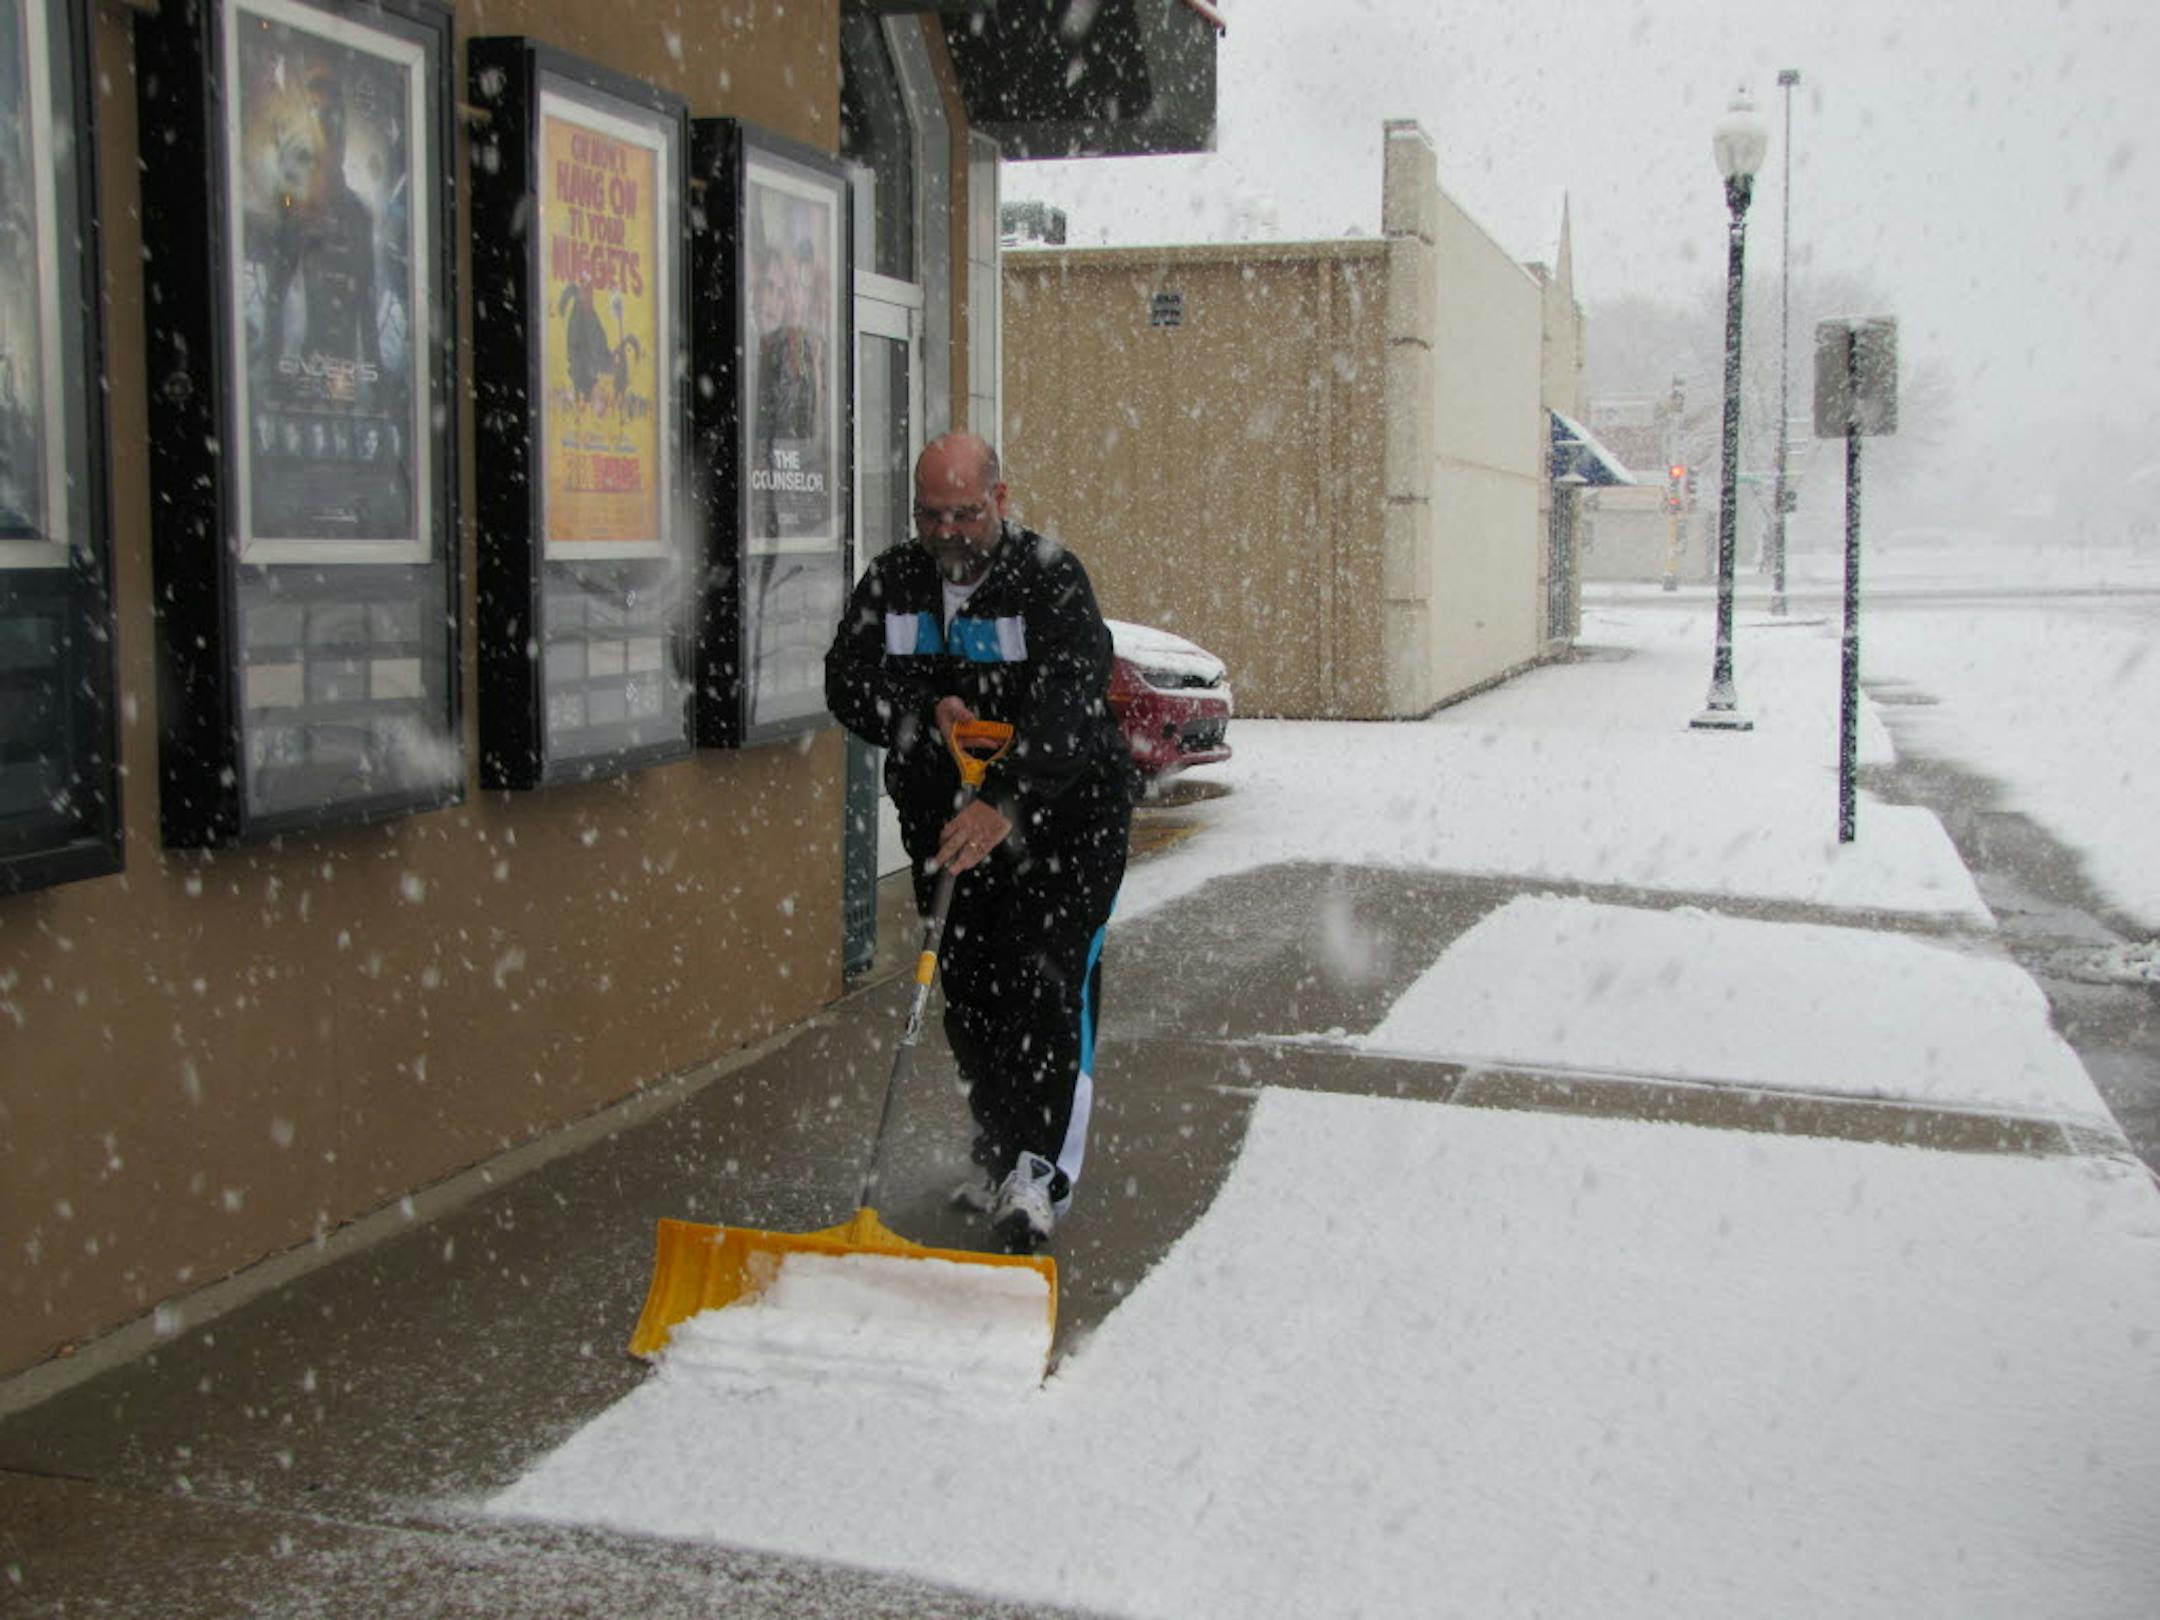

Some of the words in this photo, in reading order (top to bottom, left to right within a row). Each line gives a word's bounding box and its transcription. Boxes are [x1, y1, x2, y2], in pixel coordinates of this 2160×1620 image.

[557, 158, 604, 211] HANG
[609, 175, 637, 219] ON
[552, 235, 643, 297] NUGGETS
[773, 449, 801, 469] THE
[751, 469, 824, 492] COUNSELOR
